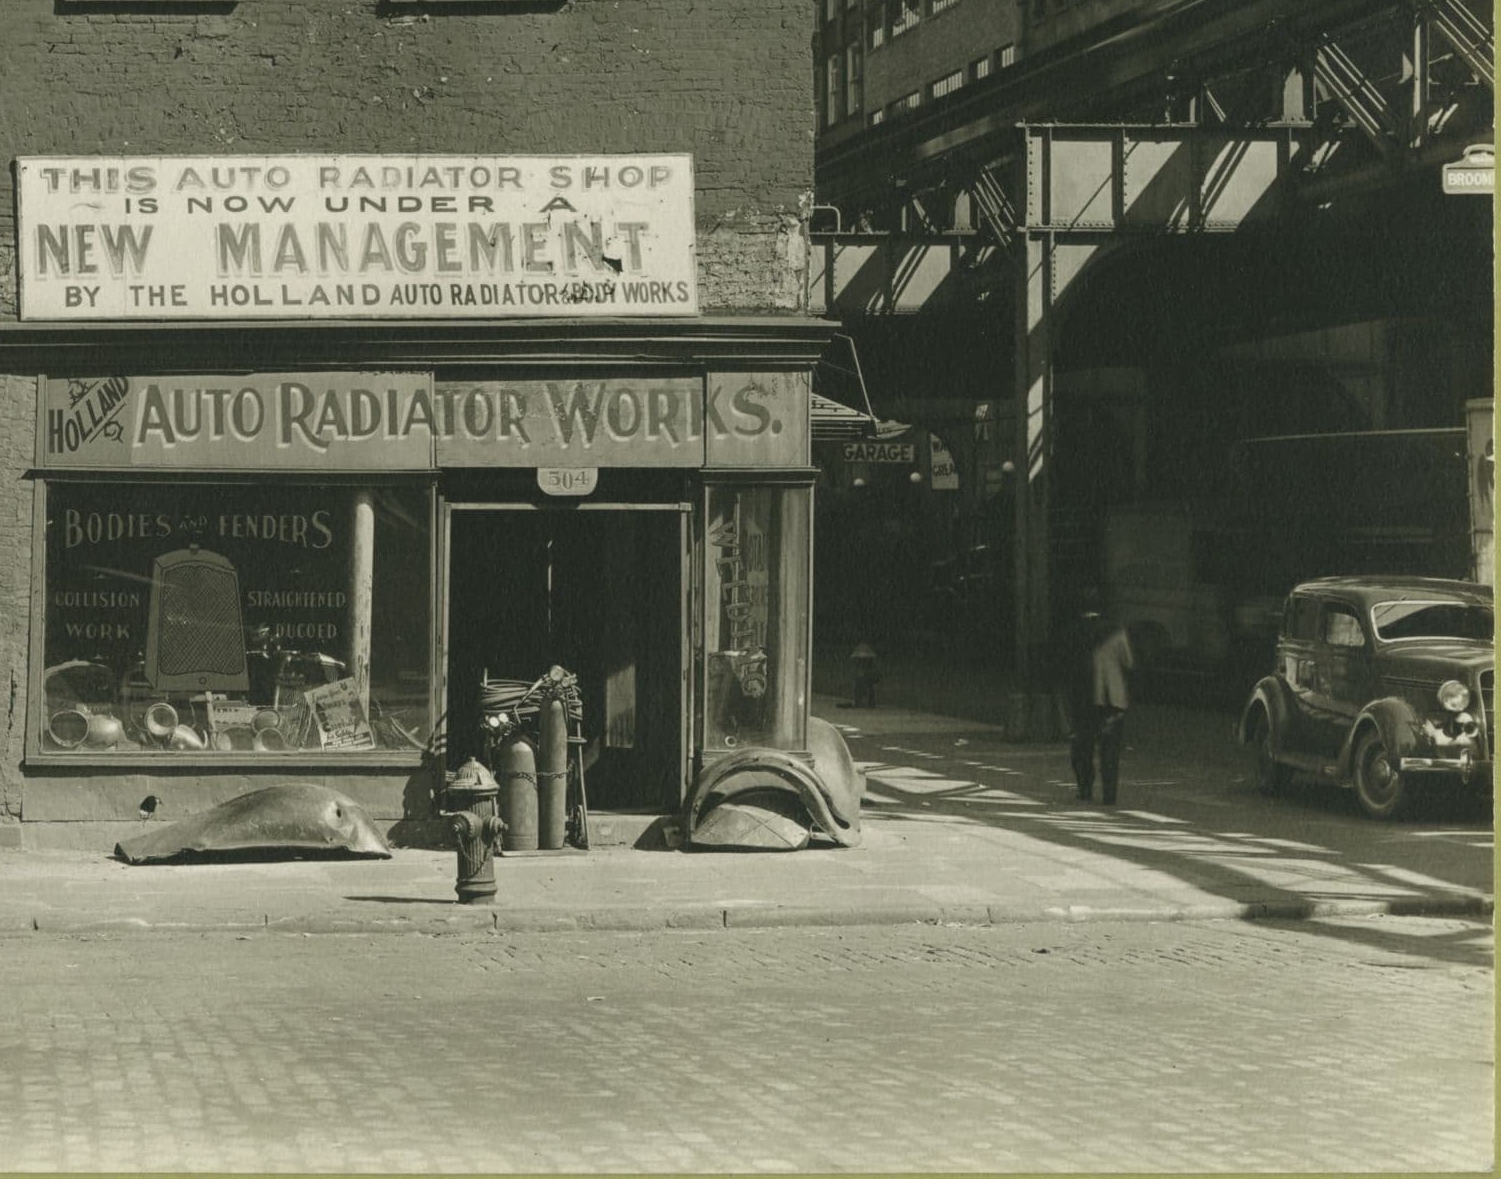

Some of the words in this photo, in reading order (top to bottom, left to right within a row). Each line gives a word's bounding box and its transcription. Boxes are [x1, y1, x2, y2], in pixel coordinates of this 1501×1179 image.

[40, 166, 158, 194] THIS
[175, 166, 291, 192] AUTO
[319, 165, 524, 191] RADIATOR
[549, 165, 672, 190] SHOP
[125, 197, 159, 214] IS
[187, 196, 297, 214] NOW
[325, 196, 495, 213] UNDER
[538, 196, 578, 213] A
[35, 222, 154, 279] NEW
[215, 221, 650, 277] MANAGEMENT
[65, 285, 101, 307] BY
[129, 285, 188, 306] THE
[210, 283, 381, 307] HOLLAND
[390, 284, 443, 305] AUTO
[450, 283, 559, 305] RADIATOR
[621, 280, 690, 304] WORKS
[48, 376, 129, 454] HOLLAND
[134, 383, 265, 447] AUTO
[277, 382, 533, 453] RADIATOR
[545, 382, 784, 449] WORKS.
[844, 444, 911, 461] GARAGE
[547, 470, 589, 490] 504
[66, 508, 172, 549] BODIES
[219, 510, 333, 549] FENDERS
[54, 590, 141, 608] COLLISION
[247, 590, 347, 608] STRAIGHTENED
[65, 622, 131, 640] WORK
[275, 622, 338, 639] DUCOED
